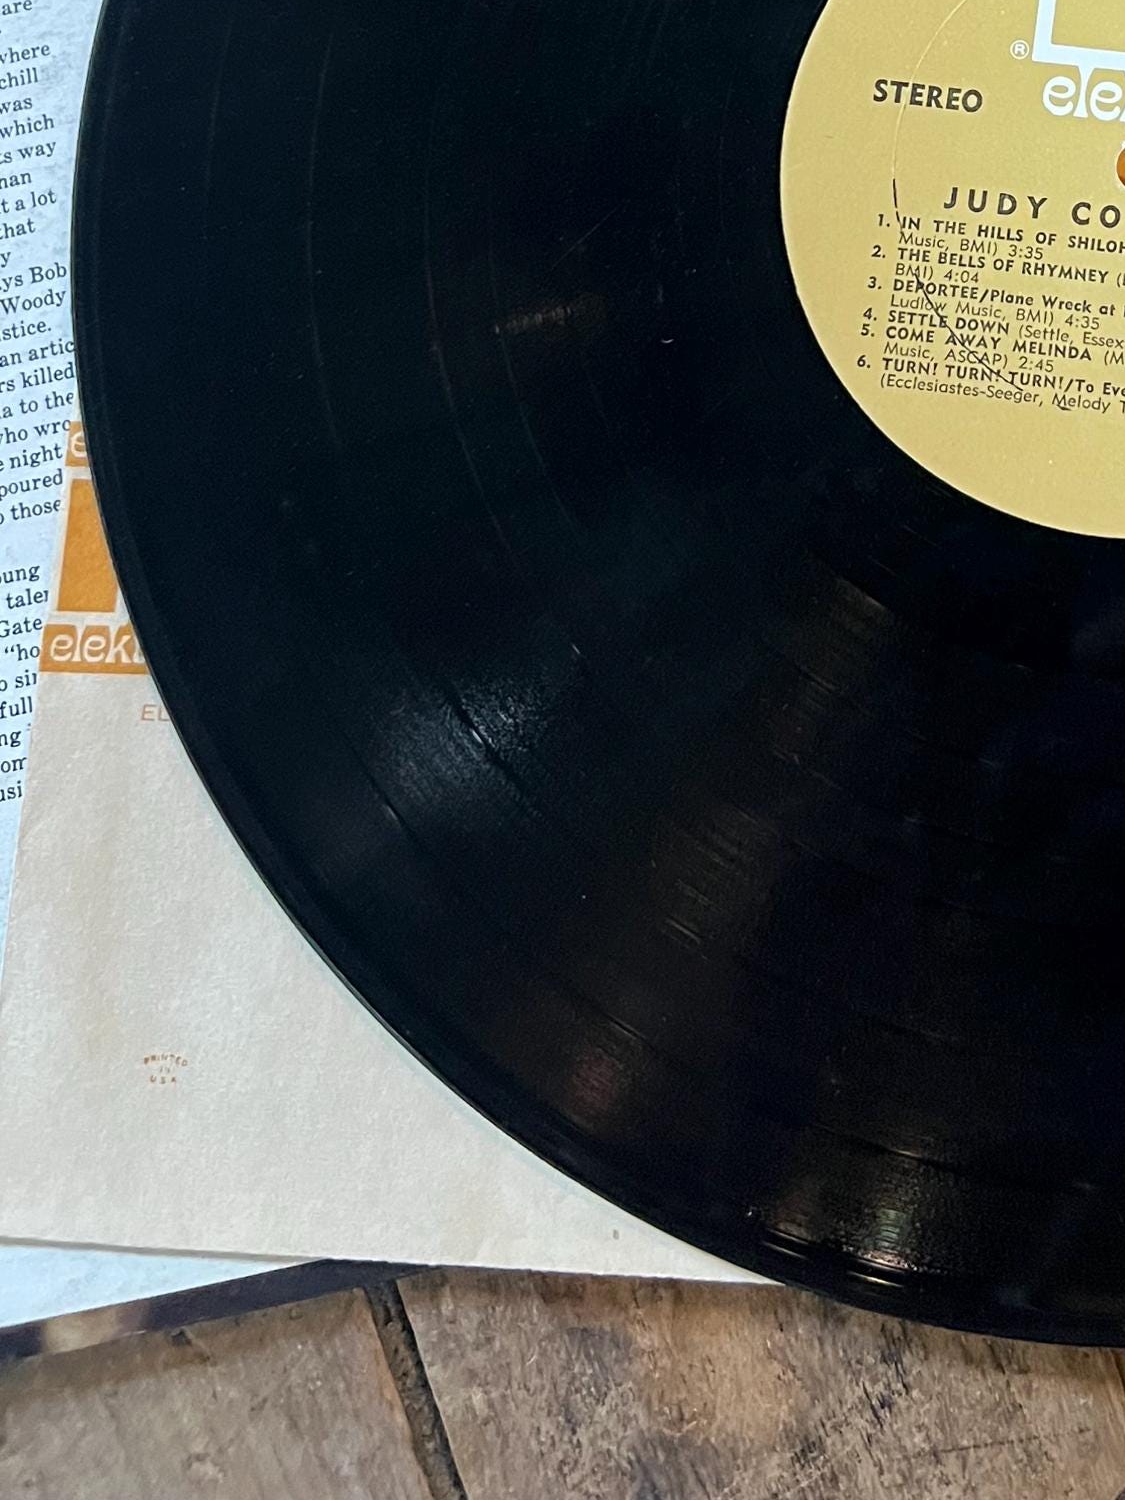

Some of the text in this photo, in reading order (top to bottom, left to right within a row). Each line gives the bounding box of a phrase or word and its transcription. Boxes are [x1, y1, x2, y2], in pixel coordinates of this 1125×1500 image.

[873, 79, 983, 113] STEREO
[19, 140, 56, 158] way
[32, 189, 57, 207] lot
[943, 186, 1047, 218] JUDY
[878, 213, 889, 227] 1.
[900, 216, 920, 230] IN
[933, 219, 966, 235] THE
[977, 224, 1023, 241] HILLS
[1035, 231, 1056, 245] OF
[898, 230, 1043, 260] Music, BMI) 3:35
[30, 262, 67, 284] Bob
[871, 244, 885, 258] 2.
[897, 247, 930, 262] THE
[937, 251, 985, 268] BELLS
[993, 258, 1014, 271] OF
[1021, 261, 1108, 283] RHYMNEY
[895, 262, 978, 283] BMI) 4:04
[2, 289, 66, 315] Woody
[867, 275, 881, 289] 3.
[1041, 294, 1091, 313] Wreck
[1098, 304, 1115, 315] at
[890, 293, 1099, 330] Ludlow Music, BMI) 4:35
[860, 323, 874, 337] 5.
[886, 325, 934, 343] COME
[944, 331, 1001, 349] AWAY
[1012, 339, 1091, 360] MELINDA
[862, 307, 876, 320] 4.
[887, 309, 948, 328] SETTLE
[955, 317, 1009, 334] DOWN
[1018, 324, 1073, 345] (Settle,
[1082, 331, 1124, 349] Essex
[883, 341, 1053, 372] Music, ASCAP) 2:45
[22, 362, 75, 389] killed
[856, 354, 870, 368] 6.
[882, 357, 937, 375] TURN!
[945, 364, 1000, 381] TURN!
[1006, 371, 1093, 392] TURN!/To
[19, 390, 74, 415] to the
[880, 373, 1042, 407] (Ecclesiastes-Seeger,
[1051, 392, 1110, 413] Melody
[10, 443, 63, 469] night
